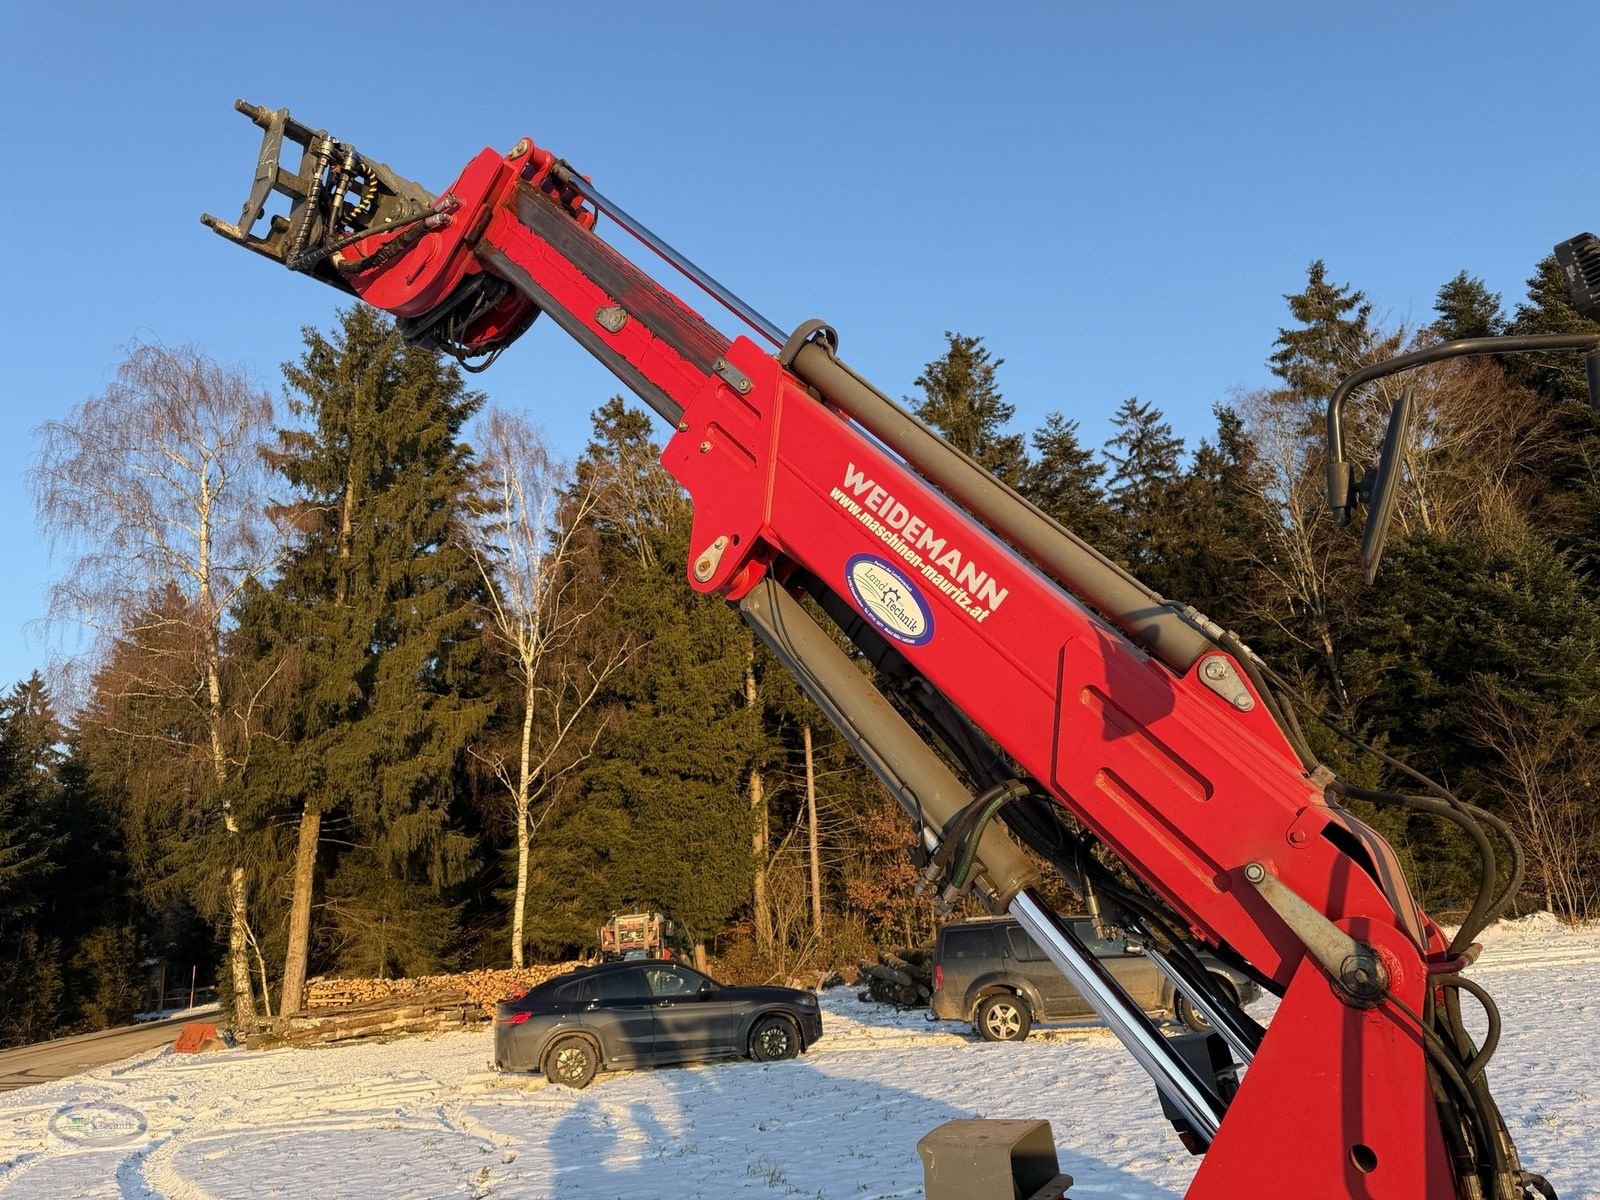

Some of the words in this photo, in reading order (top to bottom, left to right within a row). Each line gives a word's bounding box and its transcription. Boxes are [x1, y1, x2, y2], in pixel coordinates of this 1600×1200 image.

[829, 487, 990, 623] www.maschinen-mauritz.at
[843, 462, 1009, 612] WEIDEMANN
[864, 568, 889, 591] Land
[885, 597, 918, 633] Technik
